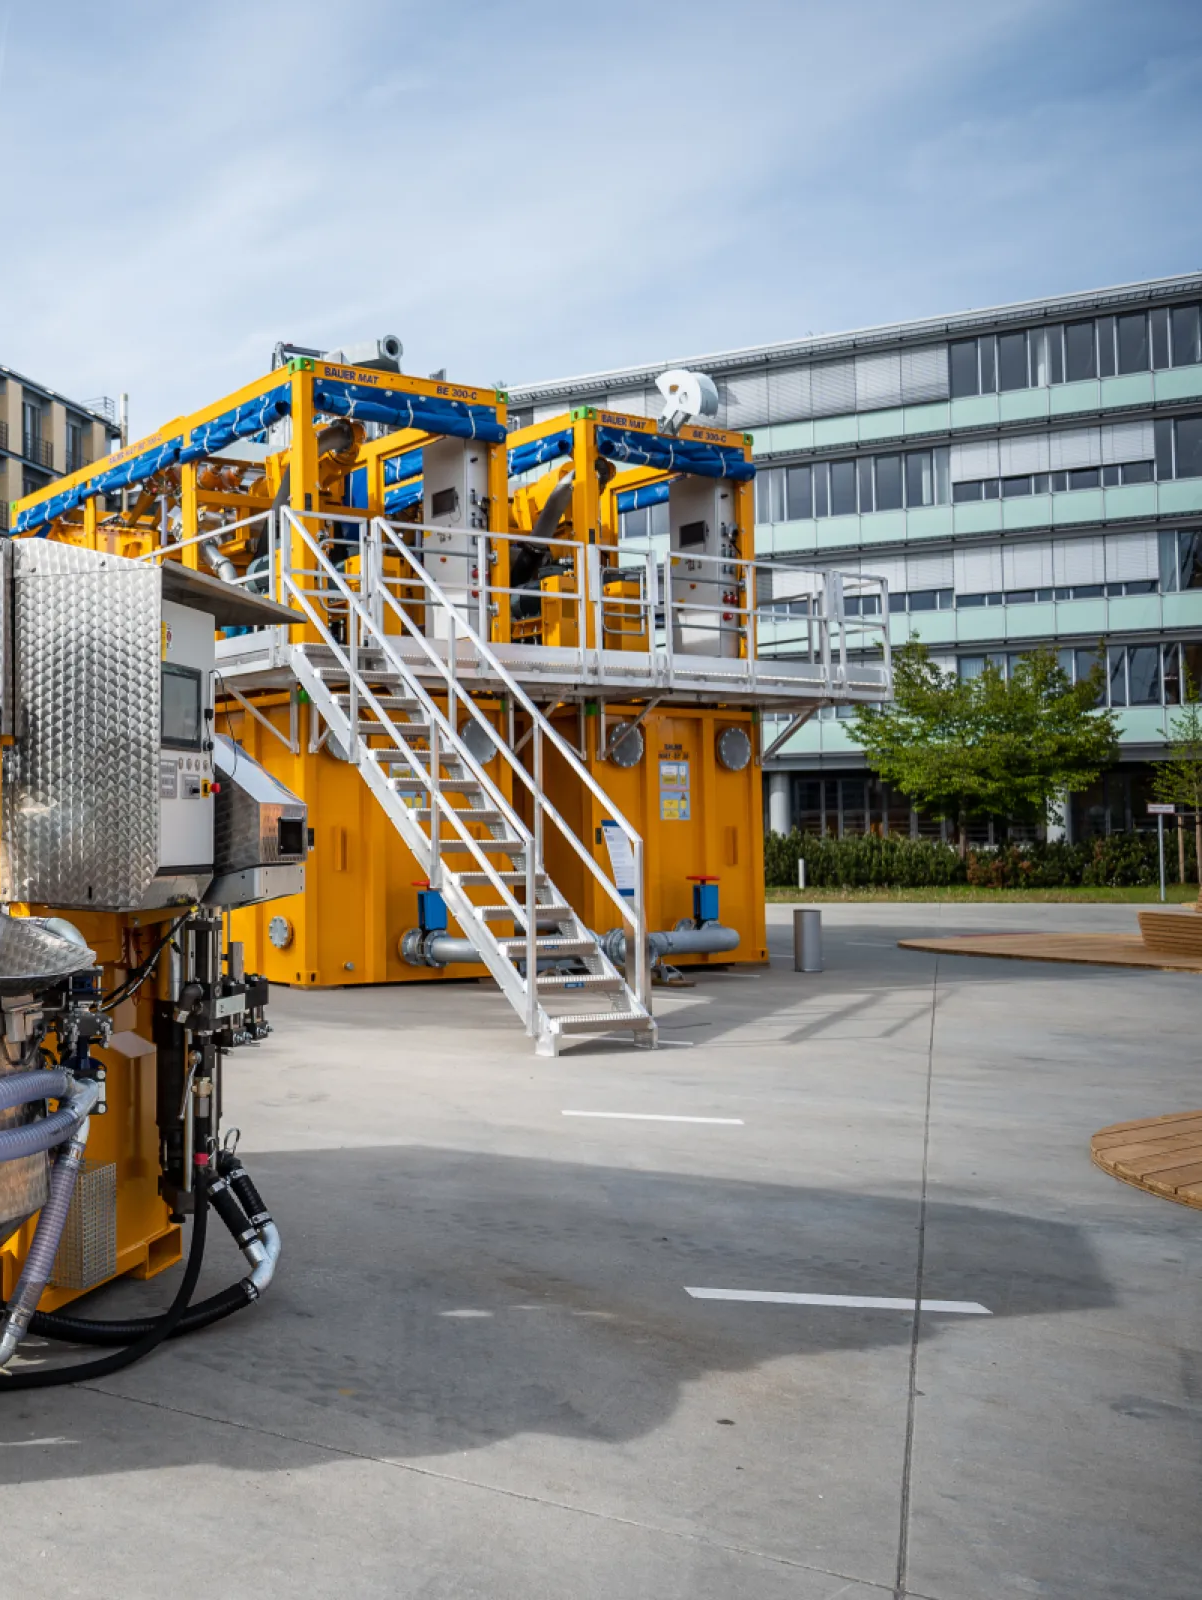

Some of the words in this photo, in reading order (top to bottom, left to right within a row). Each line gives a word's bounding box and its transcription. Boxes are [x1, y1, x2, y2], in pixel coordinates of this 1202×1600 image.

[324, 366, 355, 380] BAUER
[358, 374, 380, 384] MAT
[436, 385, 449, 396] BE
[452, 388, 478, 400] 300-C
[601, 414, 627, 425] BAUER
